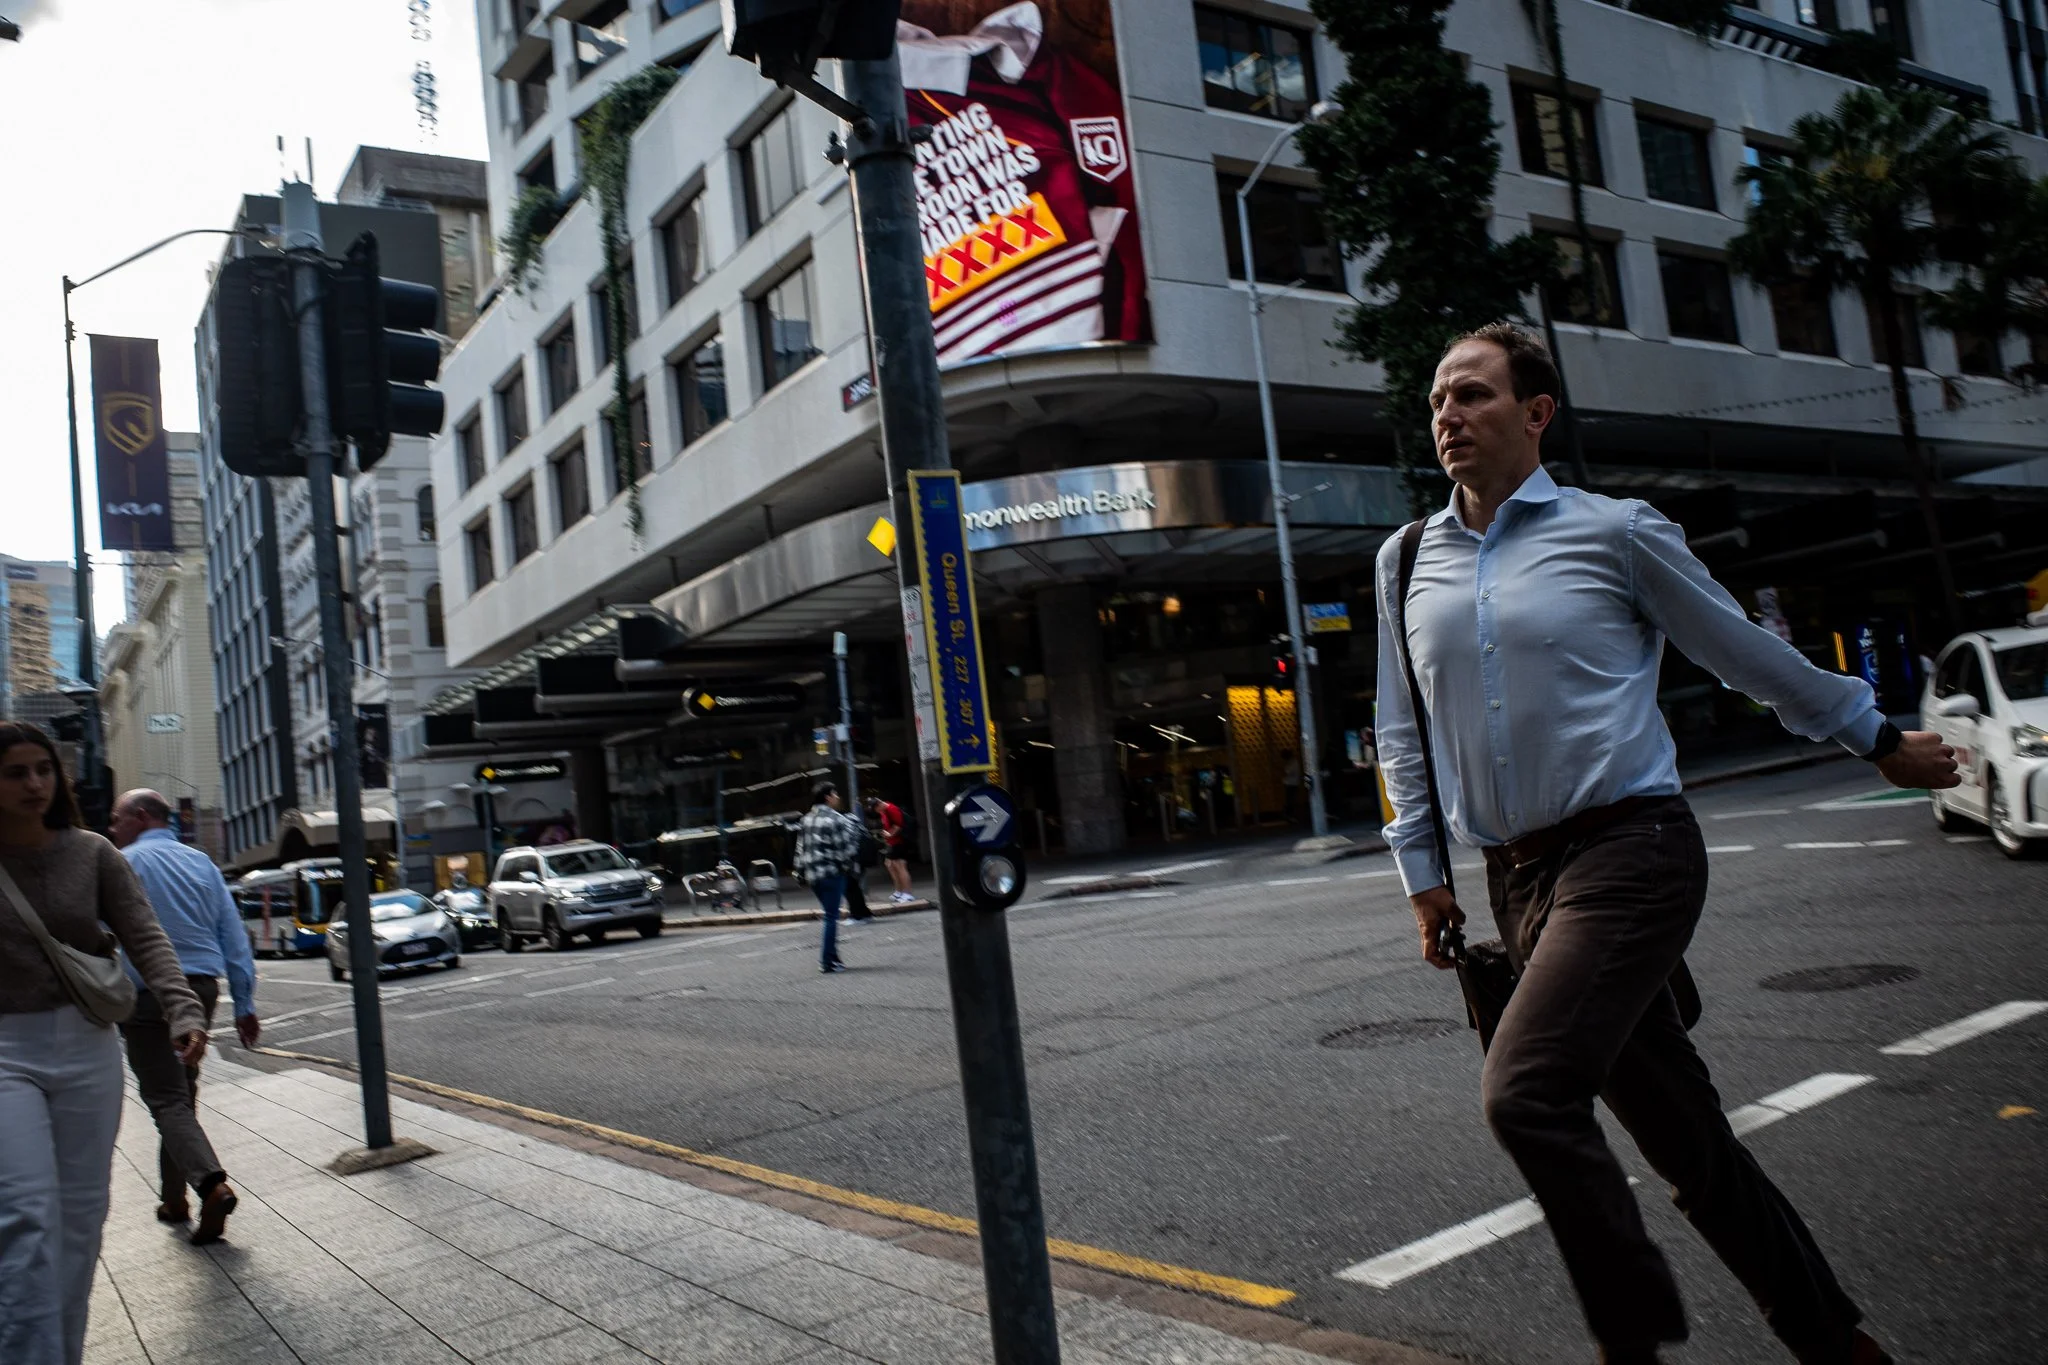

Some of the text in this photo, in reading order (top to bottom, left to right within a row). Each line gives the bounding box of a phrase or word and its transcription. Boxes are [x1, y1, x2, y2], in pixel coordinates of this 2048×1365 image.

[928, 124, 1012, 184] TOWN
[976, 143, 1041, 191] WAS
[976, 180, 1036, 226] FOR
[925, 205, 1055, 303] XXXX
[1092, 487, 1157, 514] Bank
[941, 552, 961, 614] Queen
